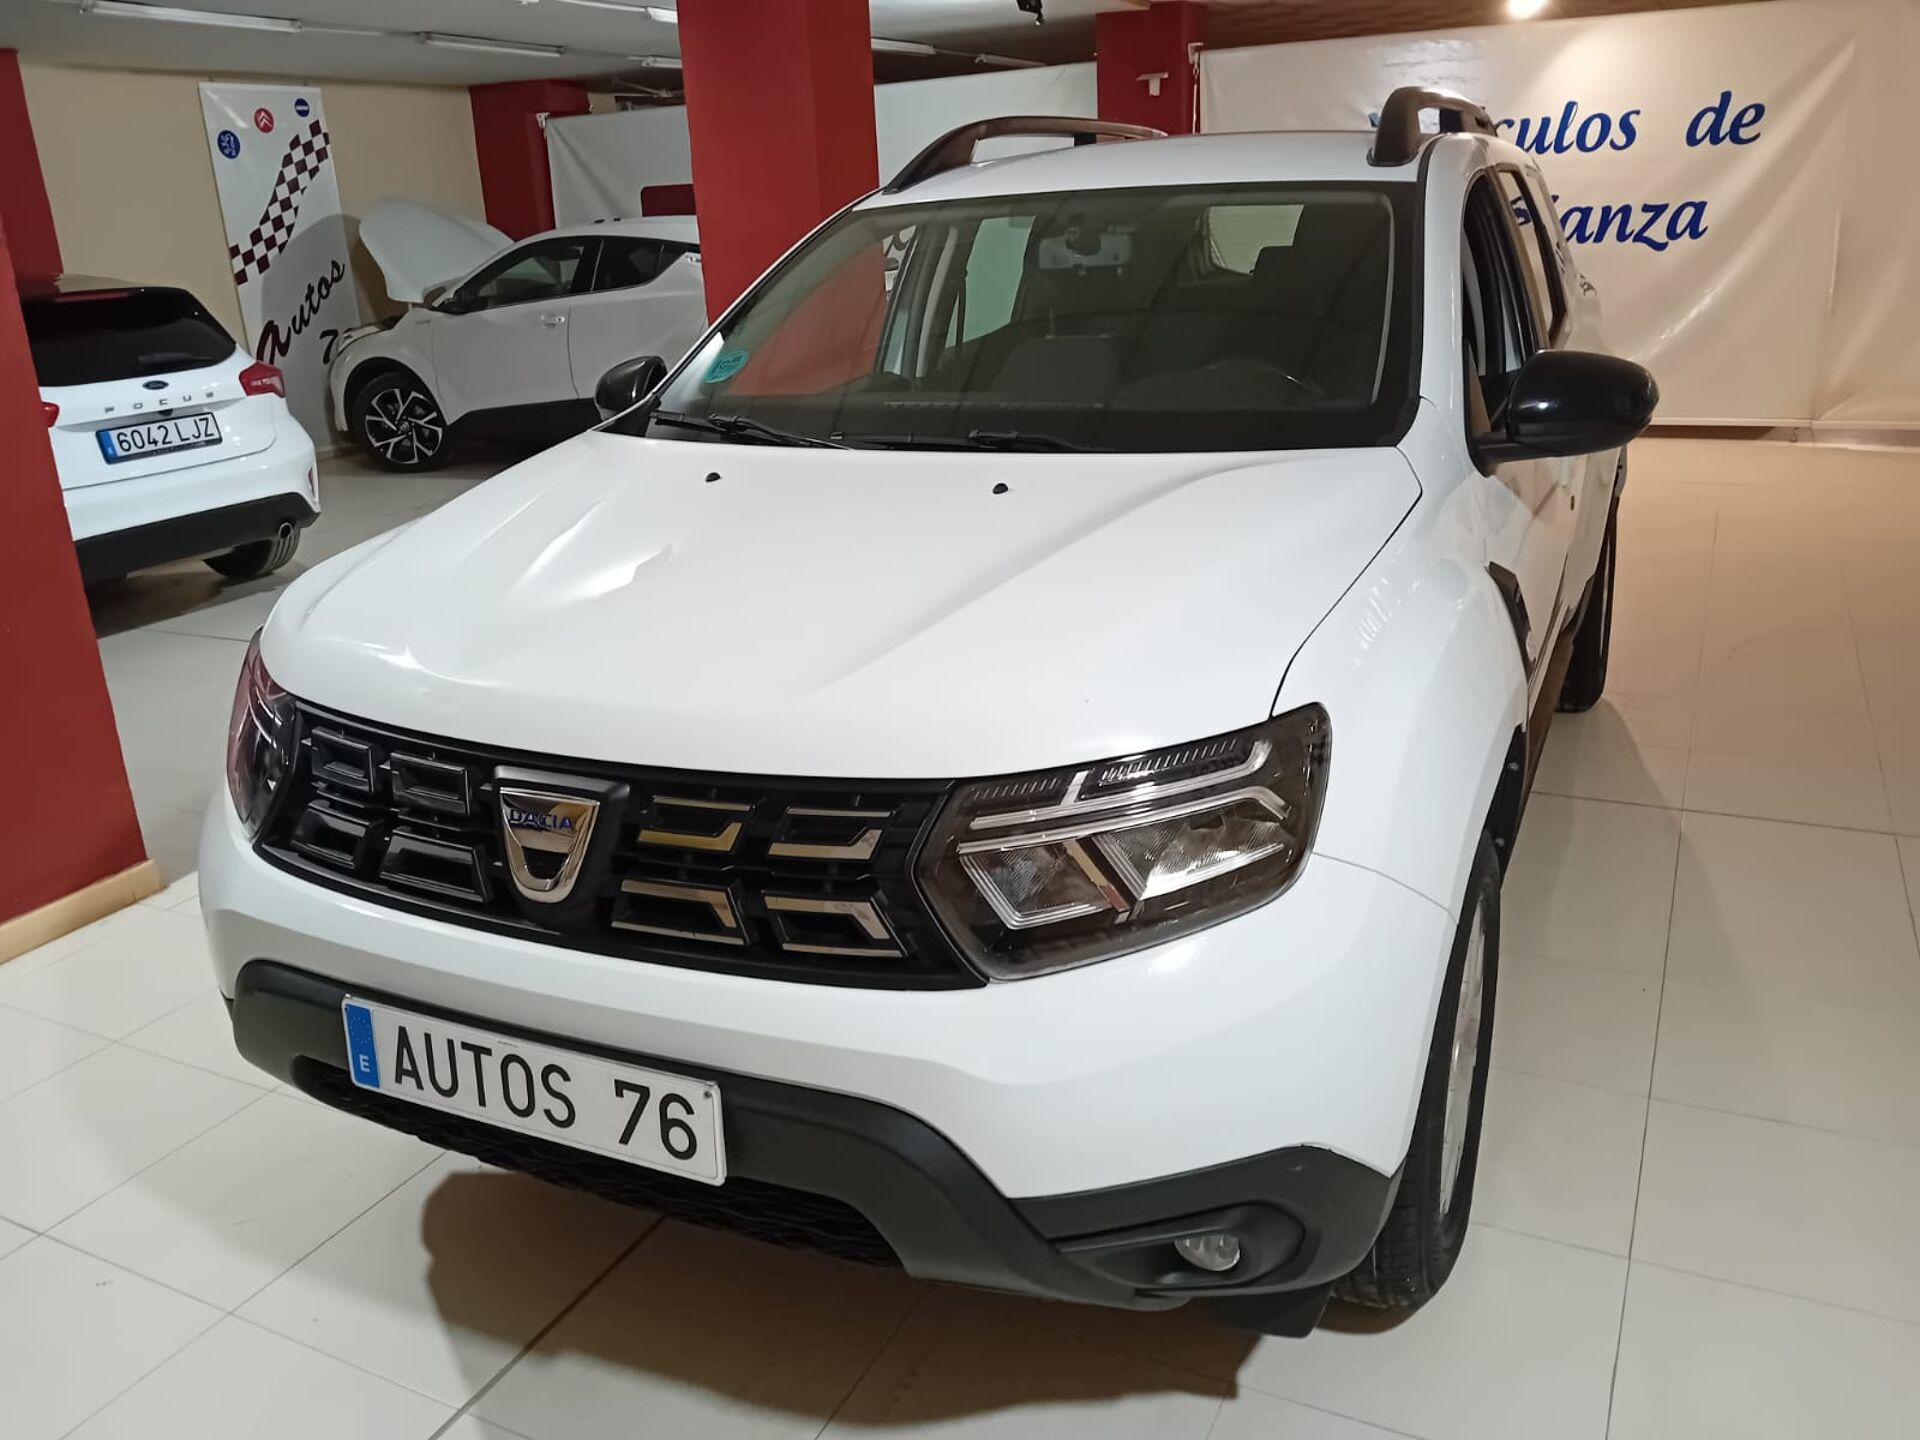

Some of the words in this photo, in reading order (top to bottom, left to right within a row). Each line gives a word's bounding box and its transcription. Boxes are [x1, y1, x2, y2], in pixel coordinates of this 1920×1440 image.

[1685, 90, 1766, 147] de
[116, 424, 173, 452] 6042
[175, 417, 215, 443] LJZ
[509, 807, 574, 830] DACIA
[359, 1054, 371, 1074] E
[394, 1025, 576, 1129] AUTOS
[613, 1078, 698, 1160] 76
